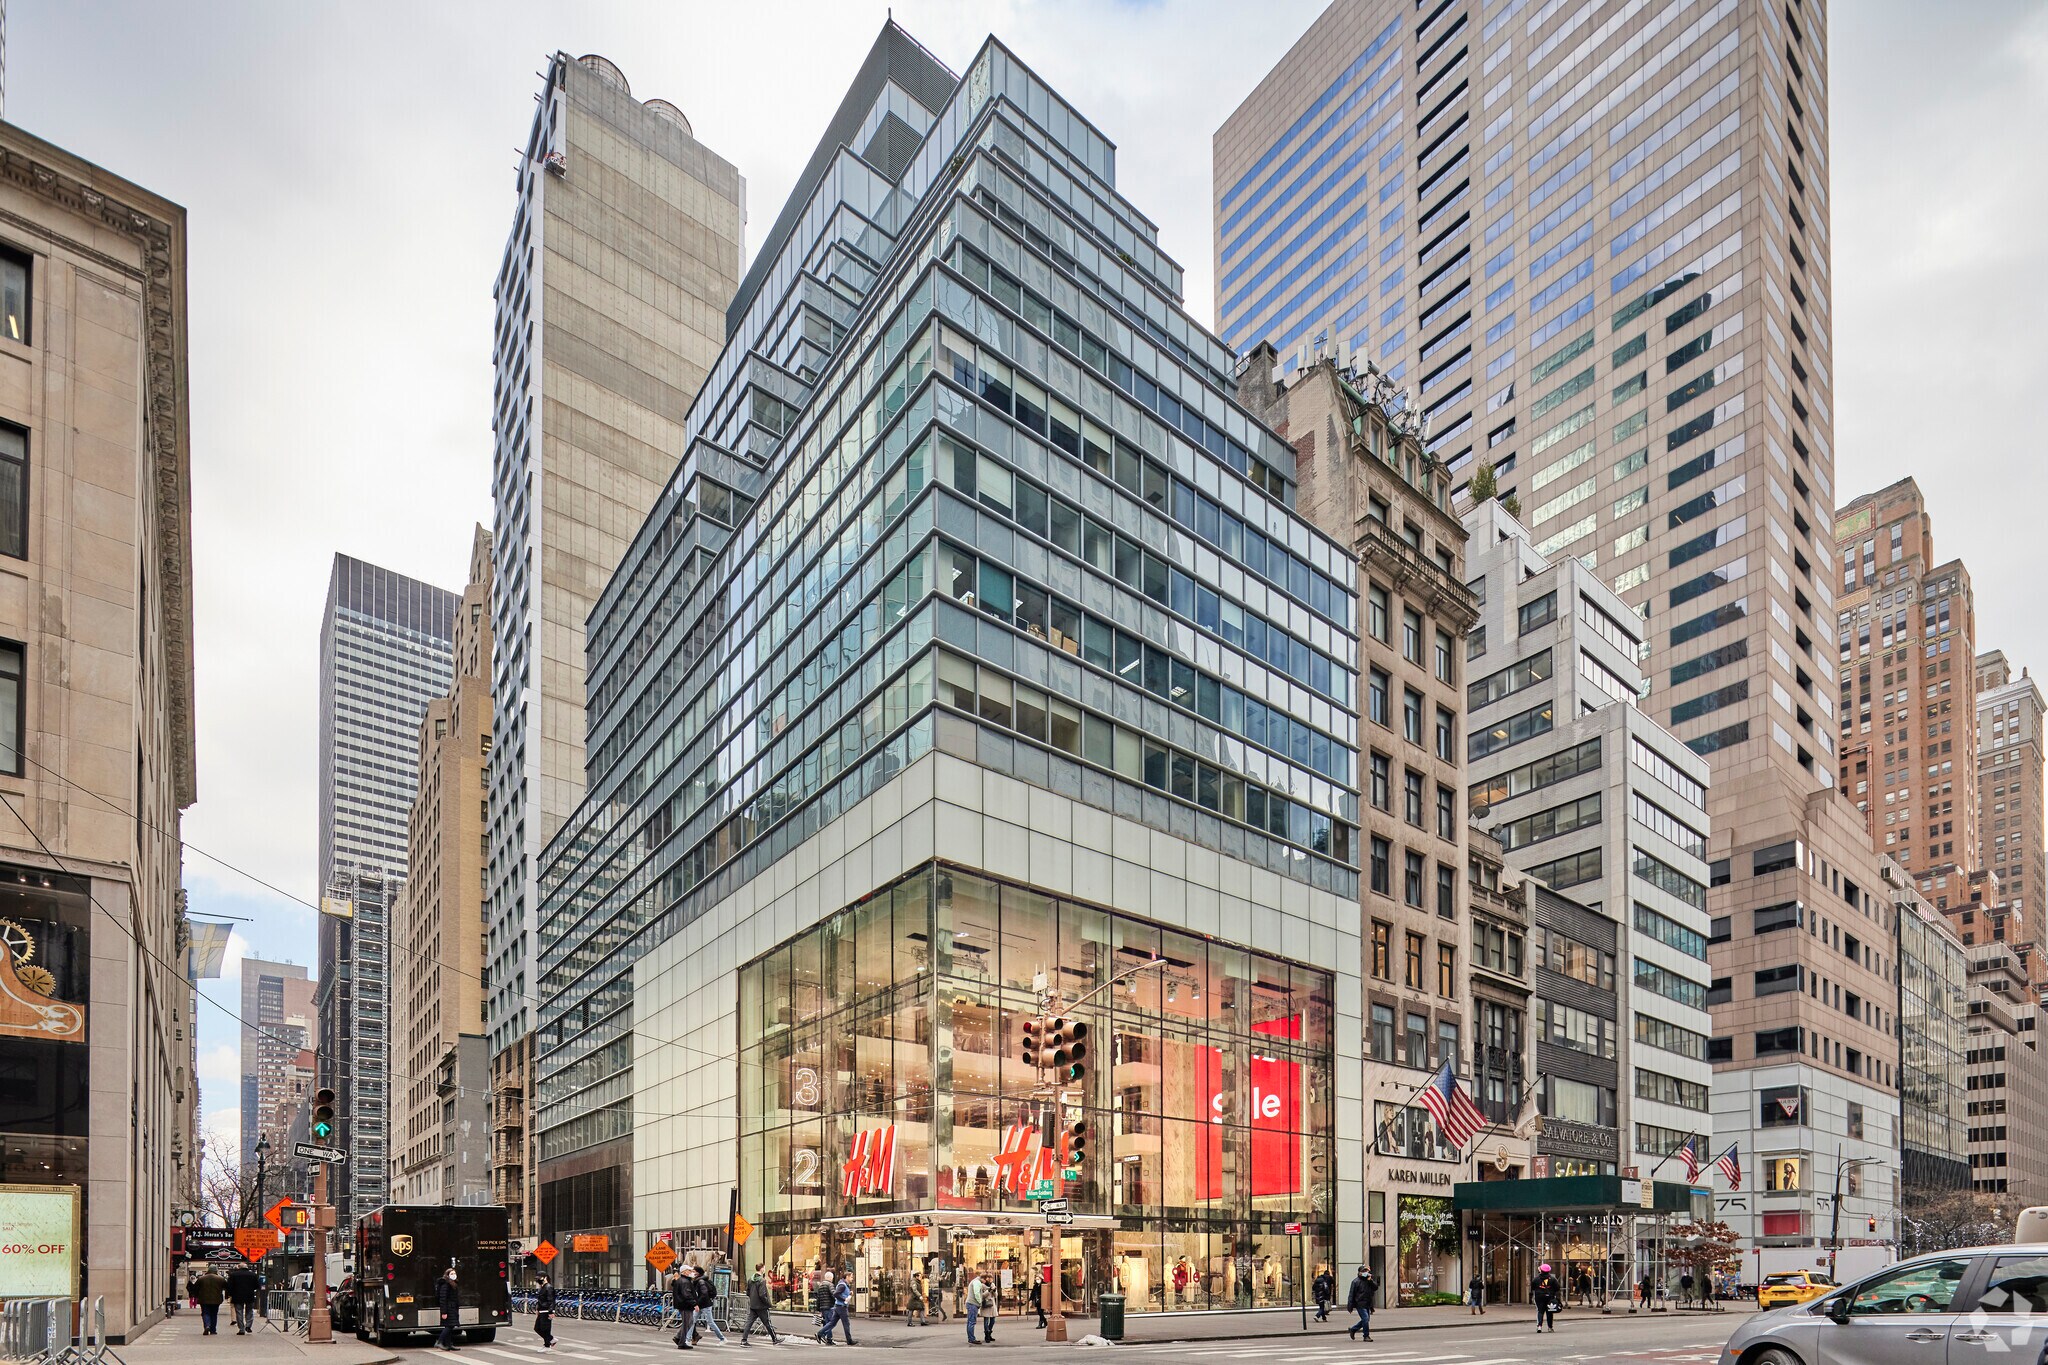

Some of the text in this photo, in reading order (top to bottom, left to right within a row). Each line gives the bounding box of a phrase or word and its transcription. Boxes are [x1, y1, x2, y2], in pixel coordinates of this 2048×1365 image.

[796, 1068, 819, 1106] 3
[1212, 1086, 1281, 1124] sle
[1542, 1123, 1589, 1144] SALVATORE
[1591, 1132, 1598, 1146] &
[299, 1146, 339, 1159] ONE WAY
[842, 1124, 898, 1198] H&M
[795, 1149, 819, 1187] 2
[1555, 1161, 1596, 1178] SALE
[1388, 1168, 1451, 1186] KAREN MILLEN
[1714, 1198, 1747, 1211] 75
[1816, 1197, 1830, 1211] 575
[1372, 1229, 1382, 1239] 587
[2, 1243, 35, 1255] 60%
[393, 1240, 411, 1253] ups
